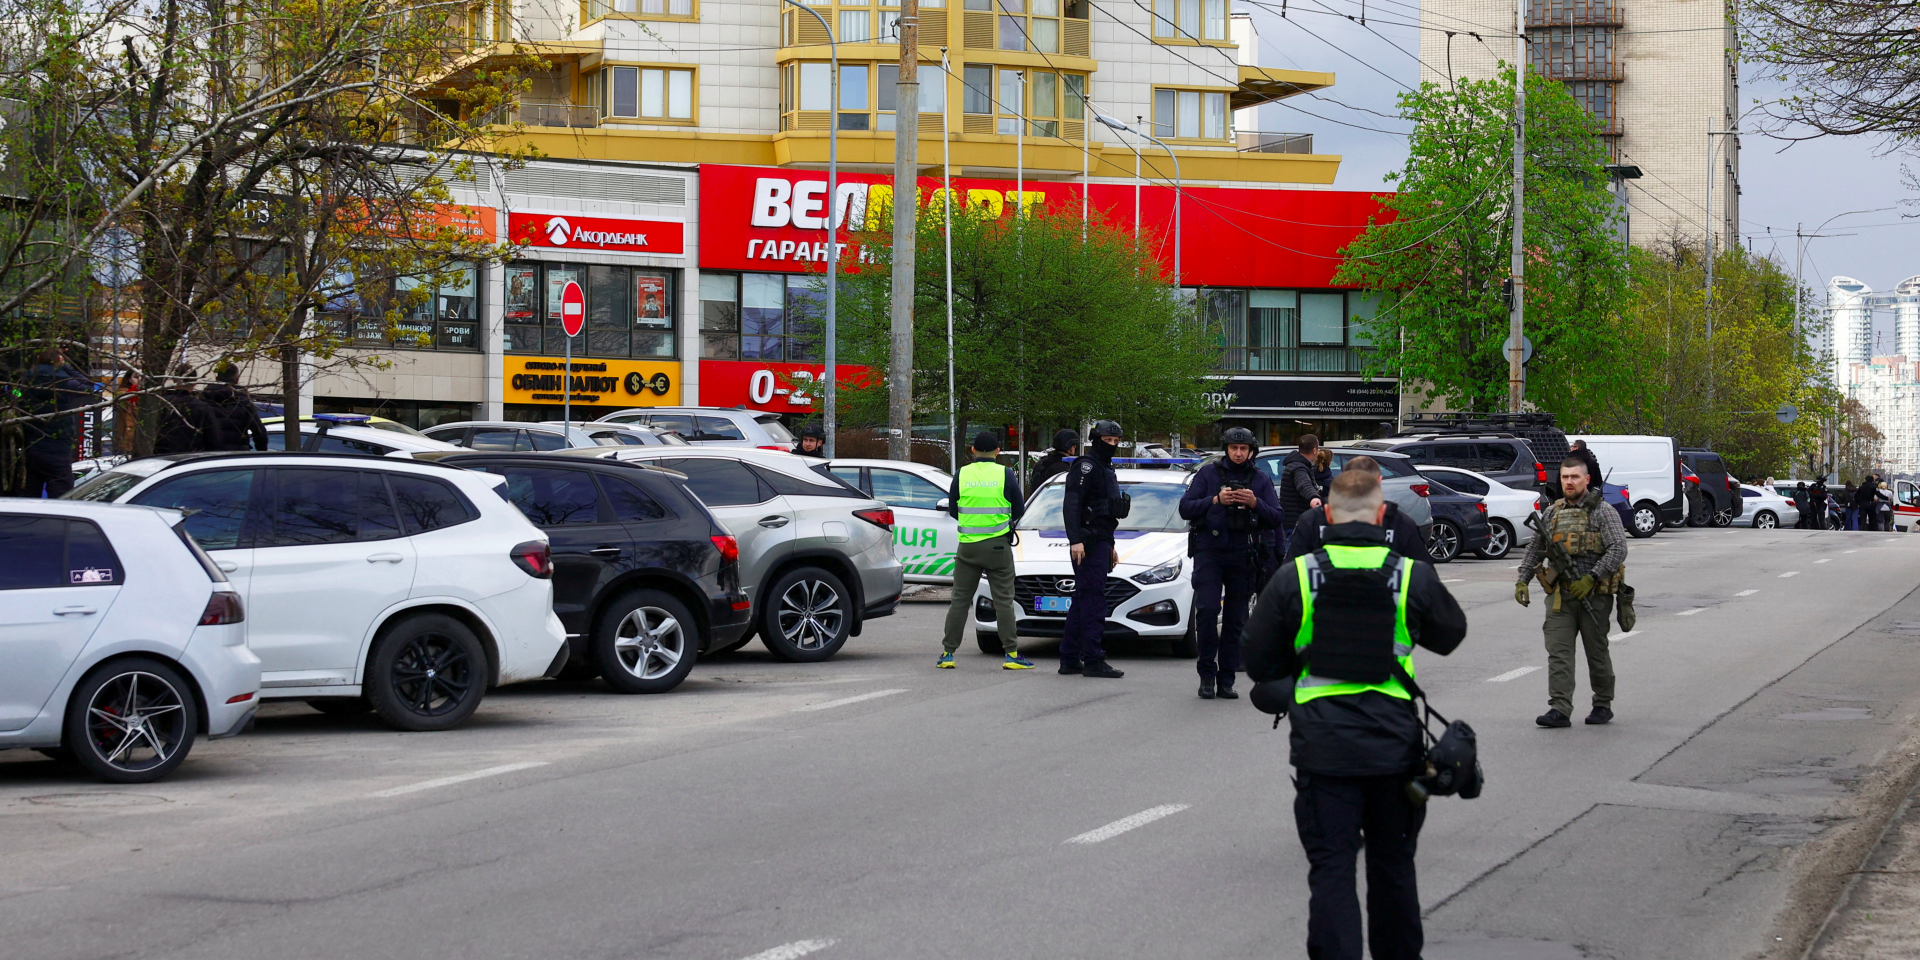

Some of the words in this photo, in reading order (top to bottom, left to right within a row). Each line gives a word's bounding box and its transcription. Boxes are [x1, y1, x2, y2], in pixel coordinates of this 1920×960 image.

[747, 239, 846, 263] ГАРАНТ
[444, 326, 470, 335] БРОВИ
[512, 373, 562, 391] ОБМІН
[564, 375, 619, 393] ВАЛЮТ
